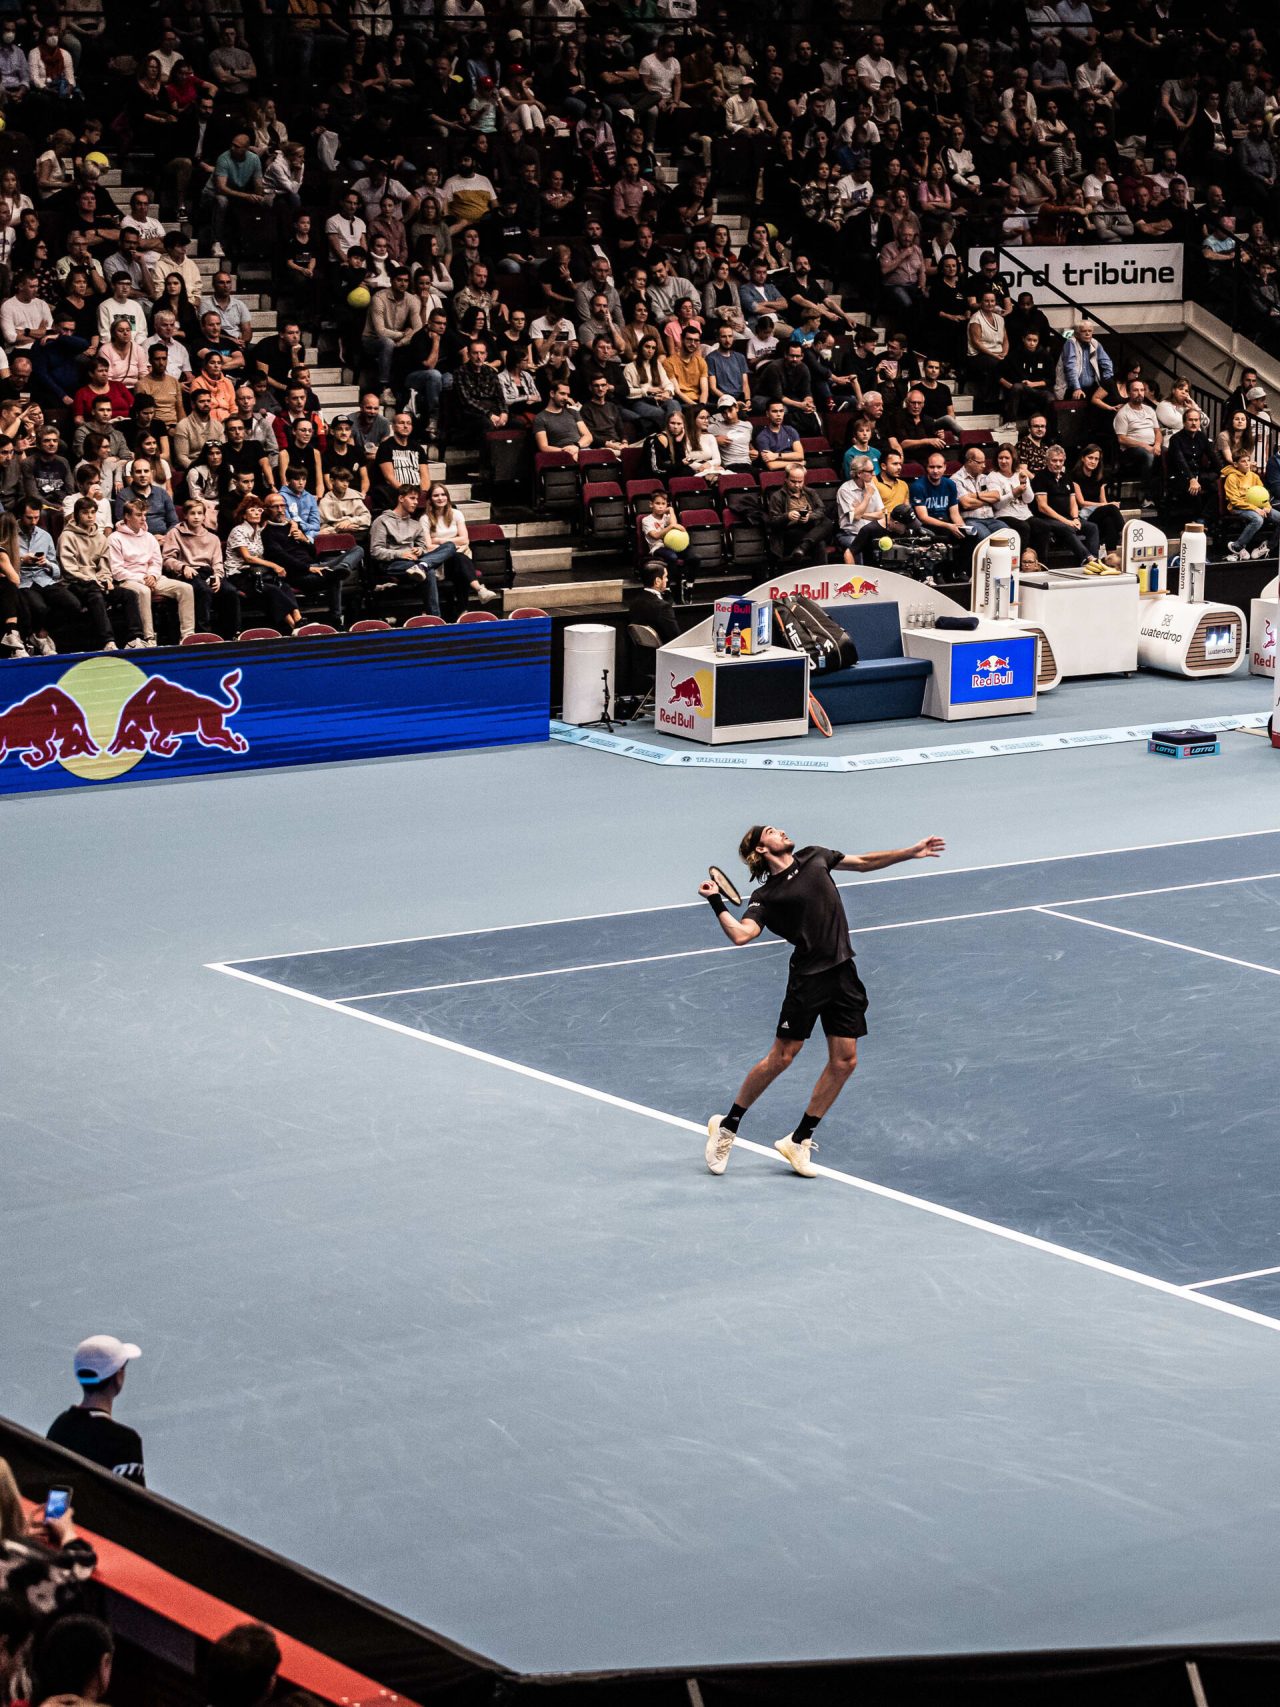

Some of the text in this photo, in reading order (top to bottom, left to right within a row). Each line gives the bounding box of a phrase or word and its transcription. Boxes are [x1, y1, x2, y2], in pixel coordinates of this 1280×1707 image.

[1000, 260, 1174, 288] ord tribüne
[769, 582, 830, 600] Red Bull
[715, 603, 733, 613] Red
[1140, 626, 1183, 644] waterdrop
[972, 671, 1014, 688] Red Bull
[660, 708, 695, 730] Red Bull
[1155, 745, 1176, 754] LOTTO
[1191, 745, 1214, 754] LOTTO
